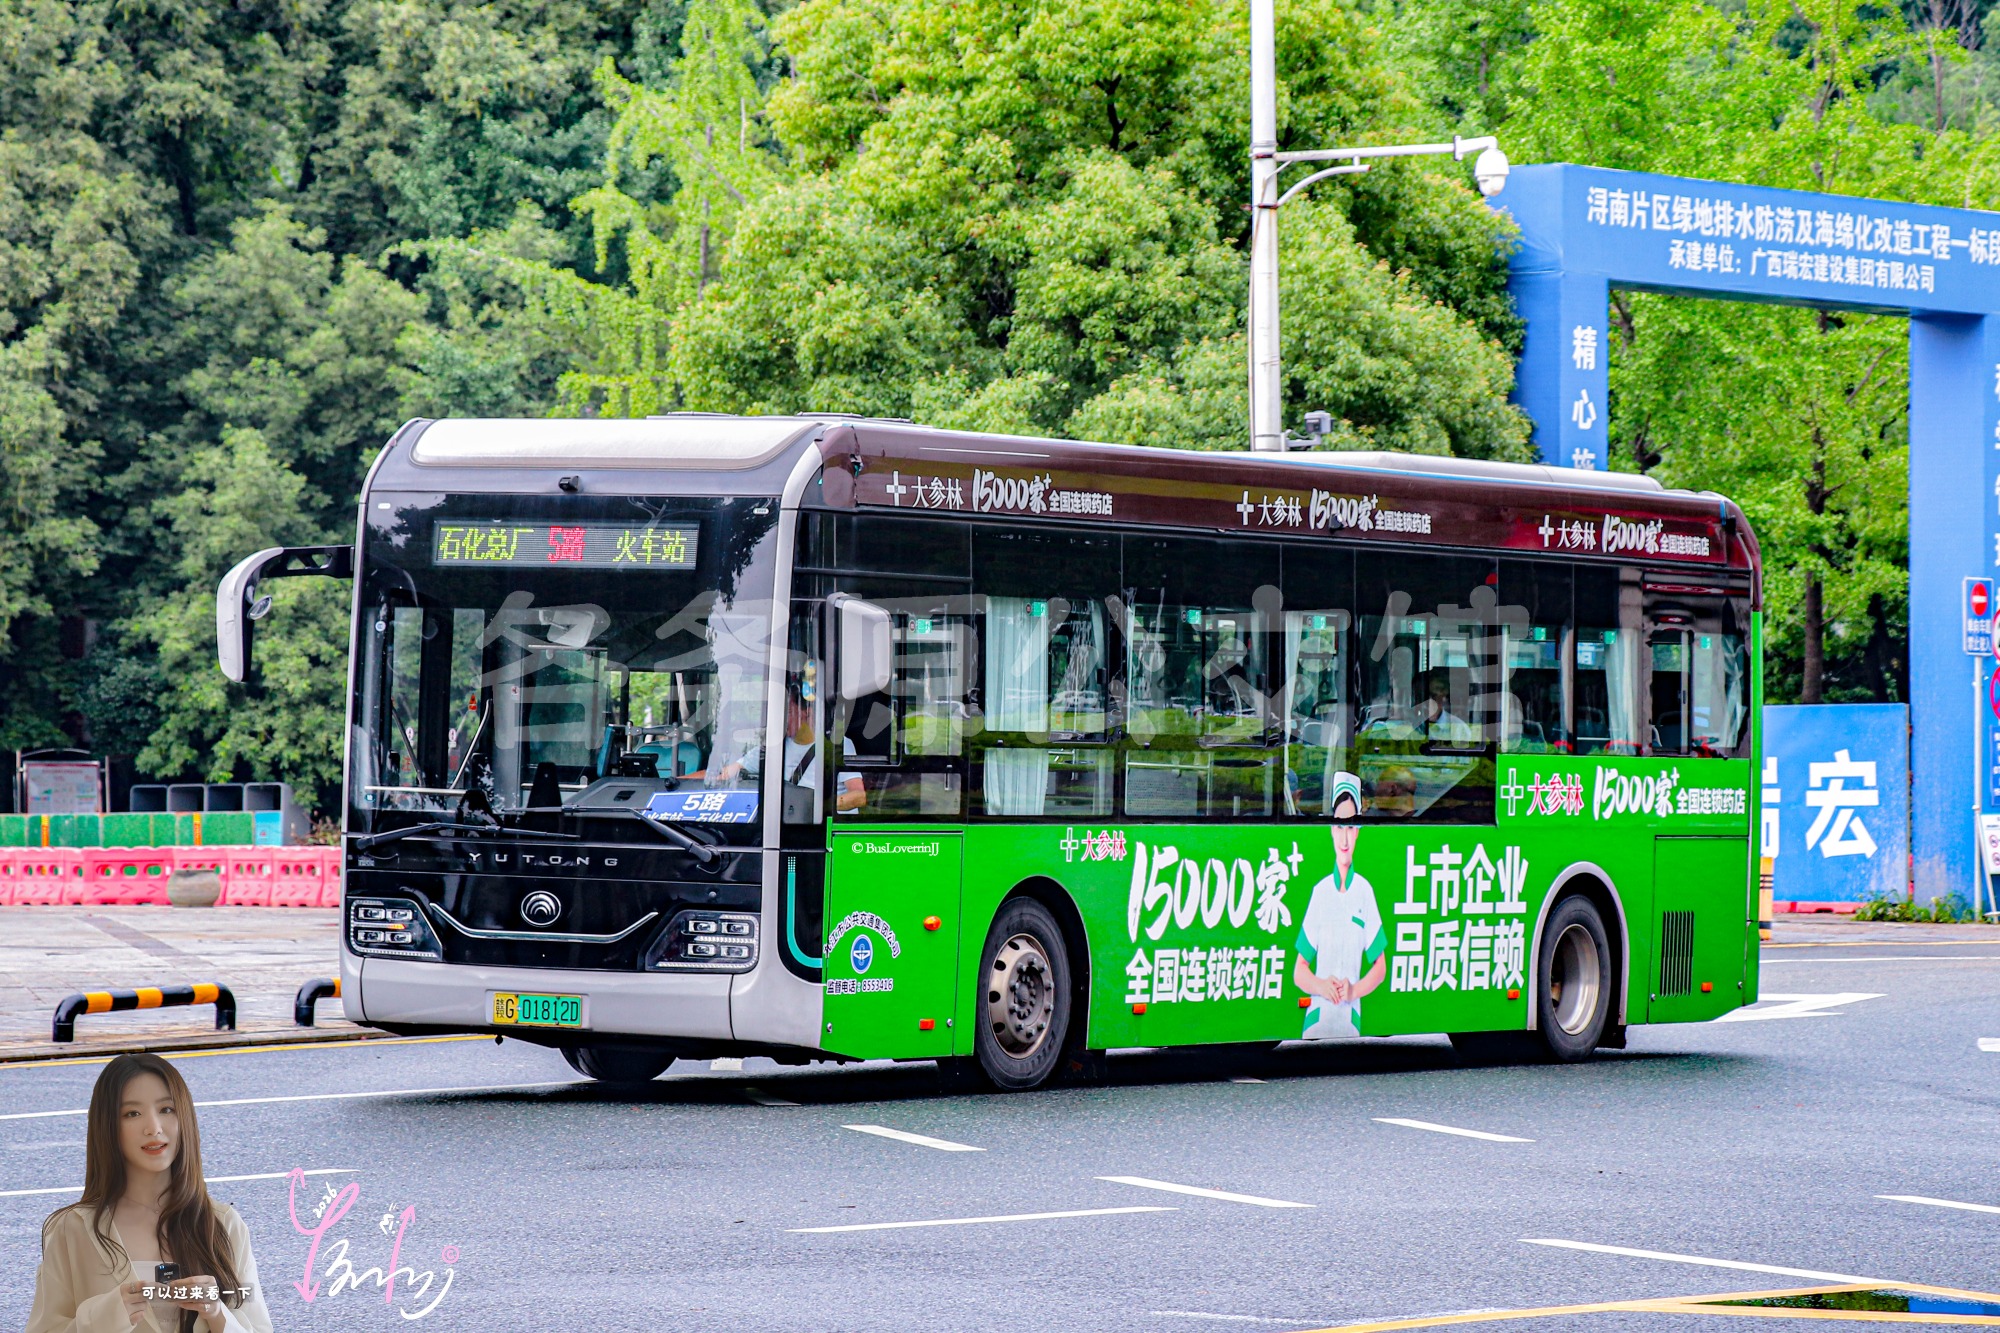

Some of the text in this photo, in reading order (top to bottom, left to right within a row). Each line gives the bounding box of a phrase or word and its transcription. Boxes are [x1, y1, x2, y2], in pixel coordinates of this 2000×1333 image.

[911, 475, 964, 510] 大参林
[1049, 489, 1113, 516] 全国连锁药店
[1257, 495, 1303, 528] 大参林
[1374, 508, 1432, 535] 全国连锁药店
[439, 525, 688, 565] 石化总厂 5路 火车站
[1556, 519, 1596, 550] 大参林
[1659, 534, 1710, 558] 全国连锁药店
[682, 792, 728, 812] 5路
[1526, 772, 1585, 817] 大参林
[1676, 788, 1746, 815] 全国连锁药店
[468, 852, 619, 867] YUTONG
[1081, 830, 1127, 862] 大参林
[1393, 843, 1529, 917] 上市企业
[1125, 945, 1286, 1004] 全国连锁药店
[1390, 917, 1526, 993] 品质信赖
